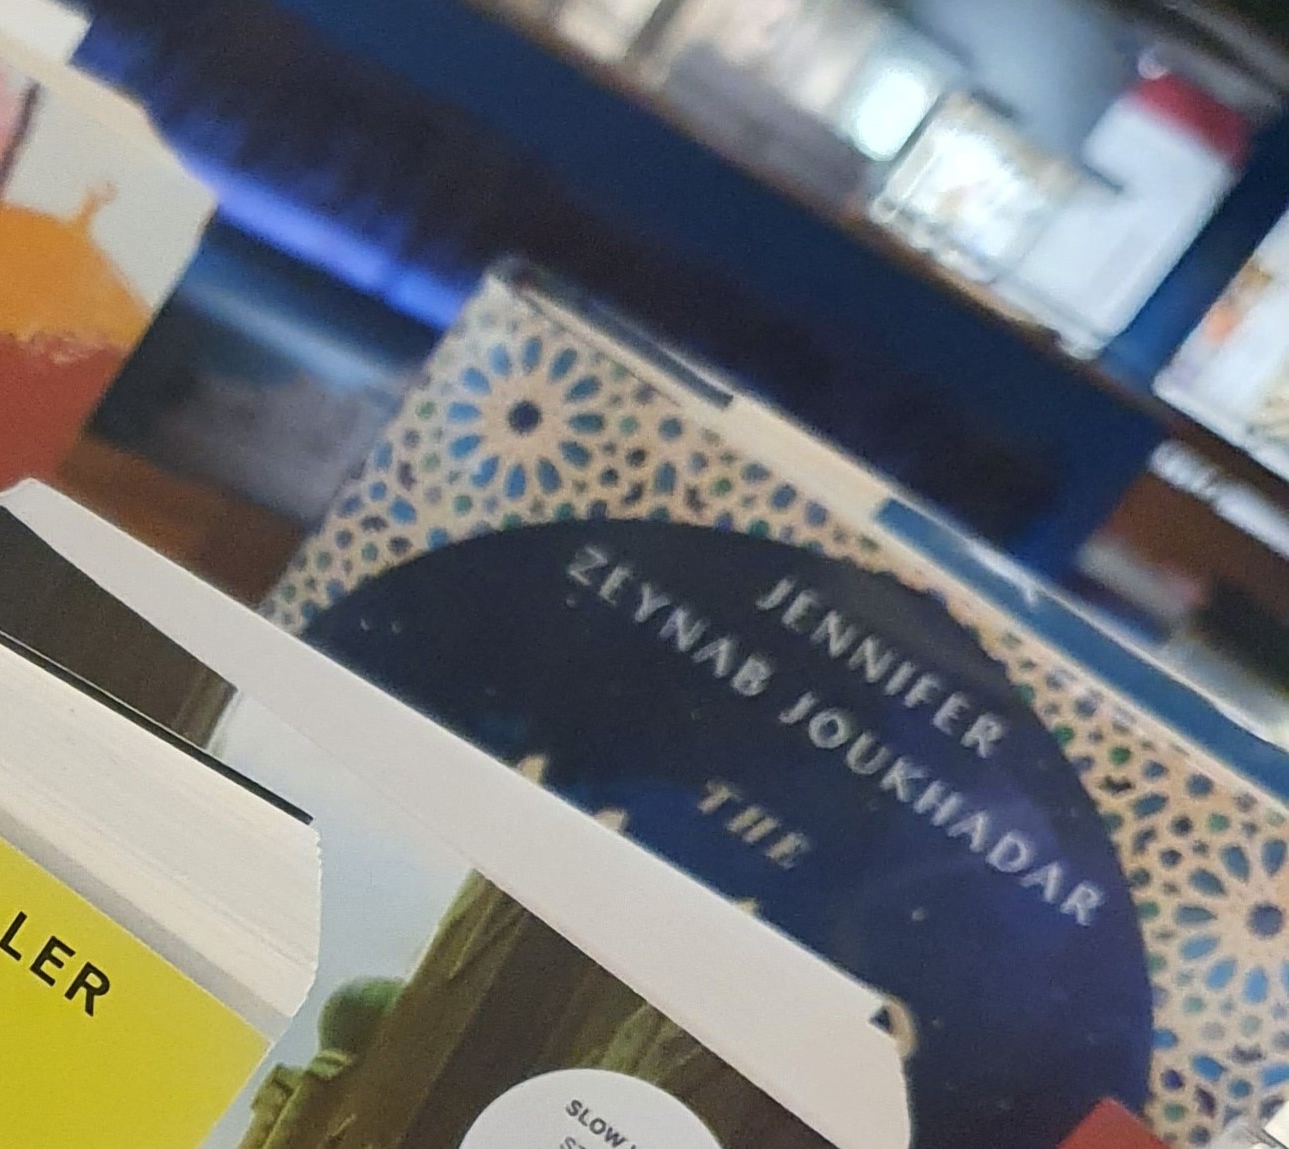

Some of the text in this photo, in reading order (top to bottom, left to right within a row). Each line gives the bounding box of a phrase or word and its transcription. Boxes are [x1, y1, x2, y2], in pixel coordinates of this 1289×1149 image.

[566, 546, 776, 697] ZEYNAB
[779, 690, 1103, 926] JOUKHADAR
[756, 577, 1008, 759] JENNIFER
[699, 779, 811, 869] THE
[565, 1099, 628, 1148] SLOW
